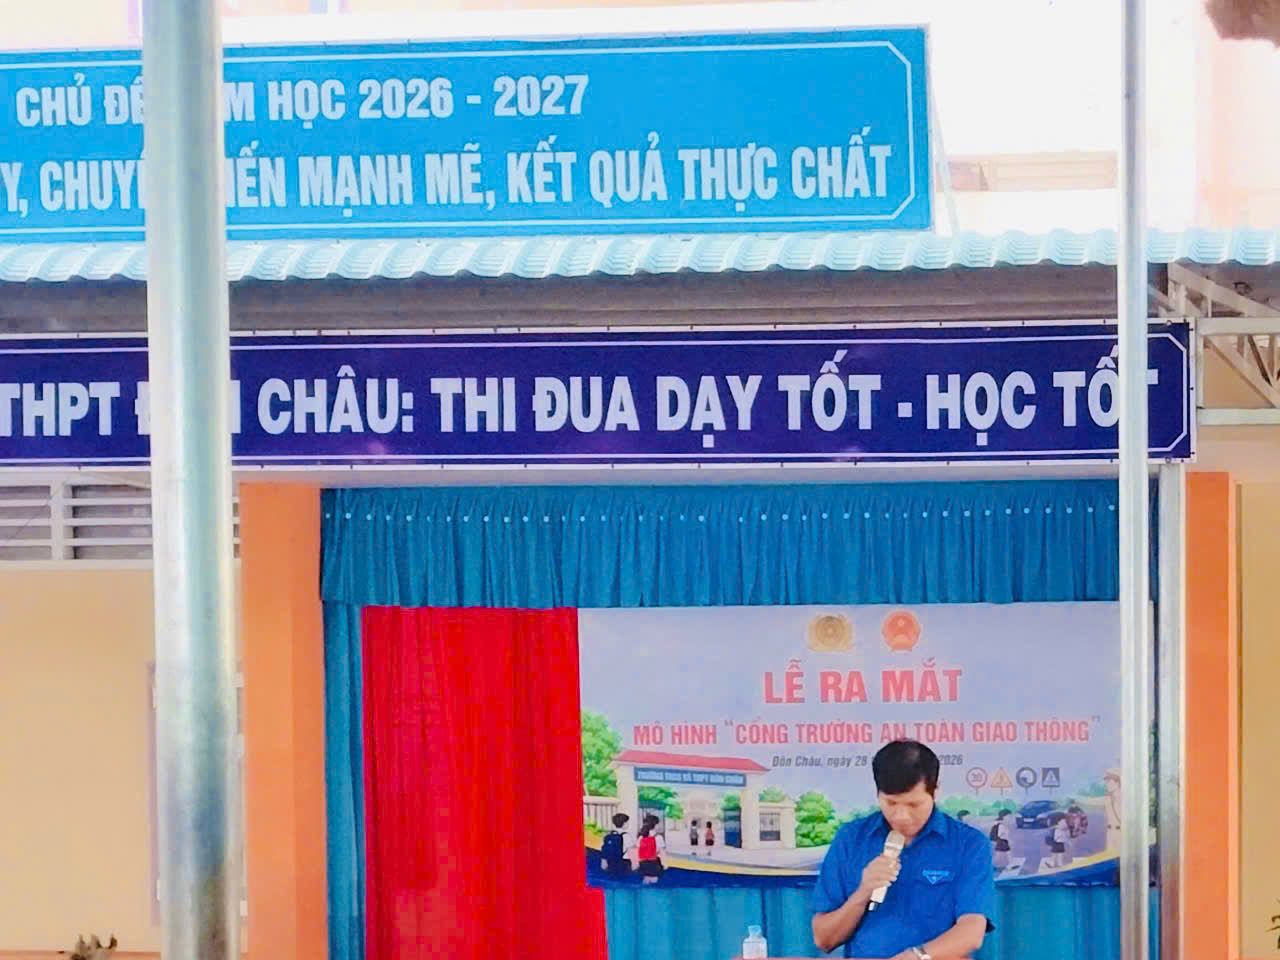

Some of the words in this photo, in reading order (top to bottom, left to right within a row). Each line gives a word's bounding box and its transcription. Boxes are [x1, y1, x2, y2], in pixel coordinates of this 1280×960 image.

[15, 72, 92, 127] CHỦ
[267, 79, 346, 129] HỌC
[358, 77, 454, 119] 2026
[466, 94, 482, 105] -
[493, 74, 589, 117] 2027
[40, 157, 145, 212] CHUY
[223, 139, 287, 208] IẾN
[299, 154, 414, 218] MẠNH
[424, 142, 496, 211] MẼ,
[506, 135, 577, 203] KẾT
[589, 131, 668, 208] QUẢ
[677, 142, 778, 212] THỰC
[791, 126, 892, 199] CHẤT
[0, 381, 120, 437] THPT
[257, 364, 414, 435] CHÂU:
[430, 376, 517, 433] THI
[532, 375, 640, 433] ĐUA
[656, 375, 762, 448] DẠY
[778, 349, 881, 432] TỐT
[926, 371, 1037, 447] HỌC
[763, 658, 805, 704] LỄ
[819, 671, 868, 703] RA
[881, 657, 962, 703] MẮT
[633, 720, 664, 745] MÔ
[671, 720, 718, 745] HÌNH
[795, 717, 873, 744] TRƯỜNG
[913, 718, 964, 743] TOÀN
[972, 721, 1018, 742] GIAO
